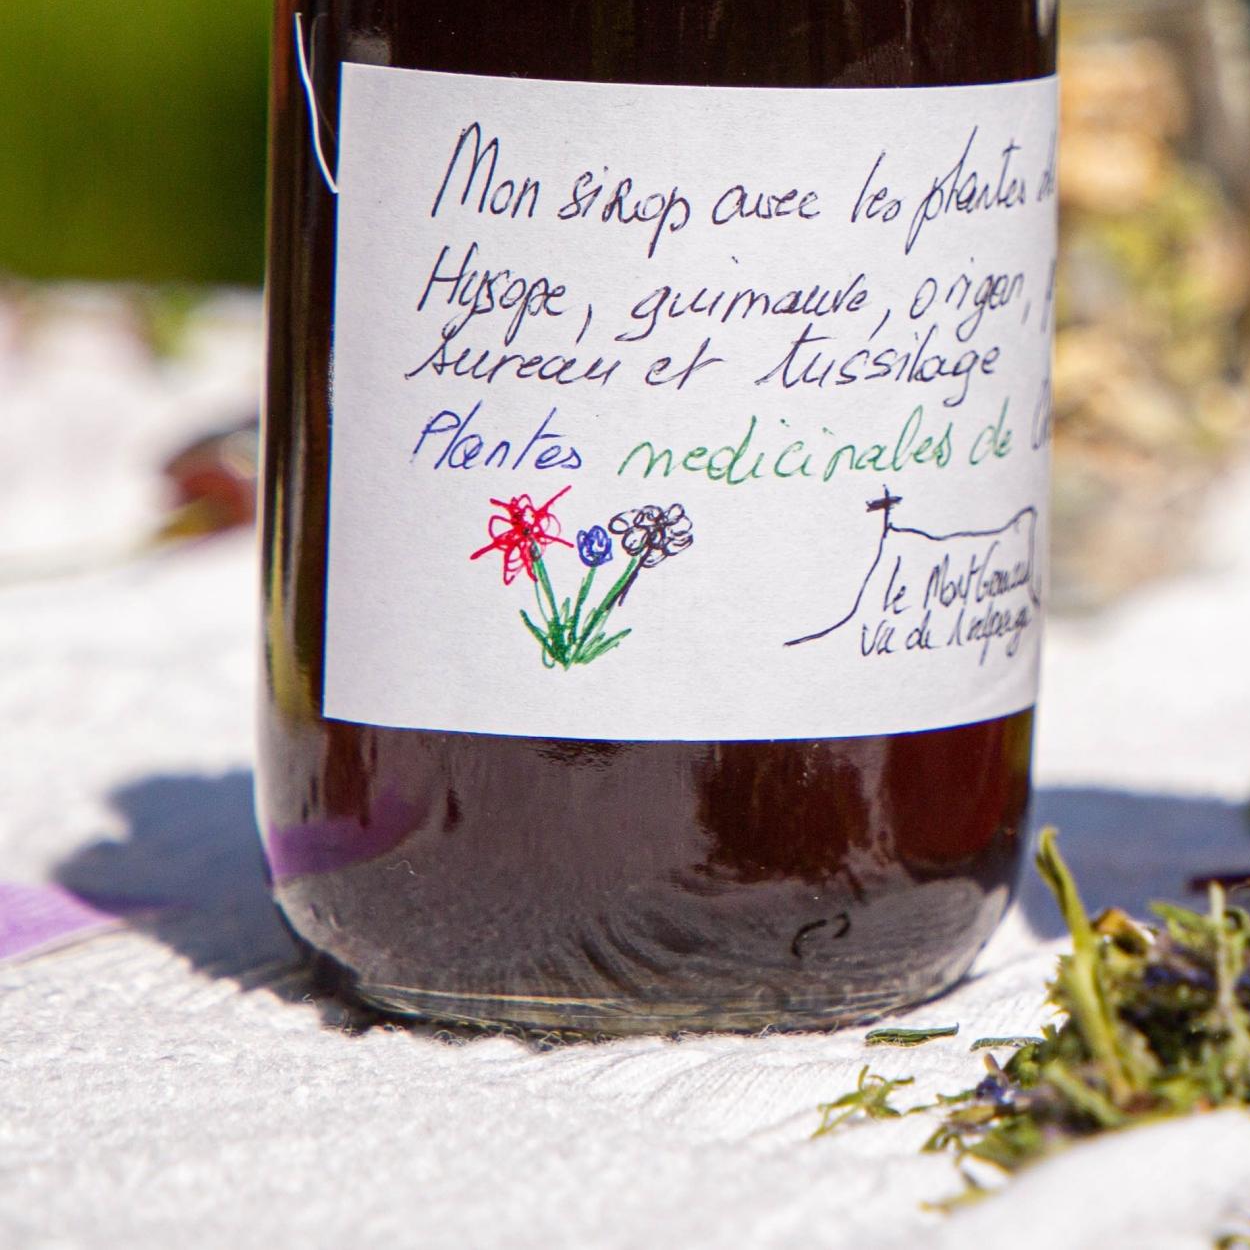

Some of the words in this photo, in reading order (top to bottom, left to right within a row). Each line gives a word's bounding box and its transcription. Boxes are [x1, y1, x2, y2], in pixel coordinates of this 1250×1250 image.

[431, 121, 541, 218] Mon
[711, 184, 822, 225] avec
[851, 150, 903, 223] les
[904, 125, 1027, 256] plantes
[645, 337, 728, 390] et
[754, 322, 1001, 407] tussilage
[410, 400, 582, 470] Plantes
[969, 396, 1012, 467] de
